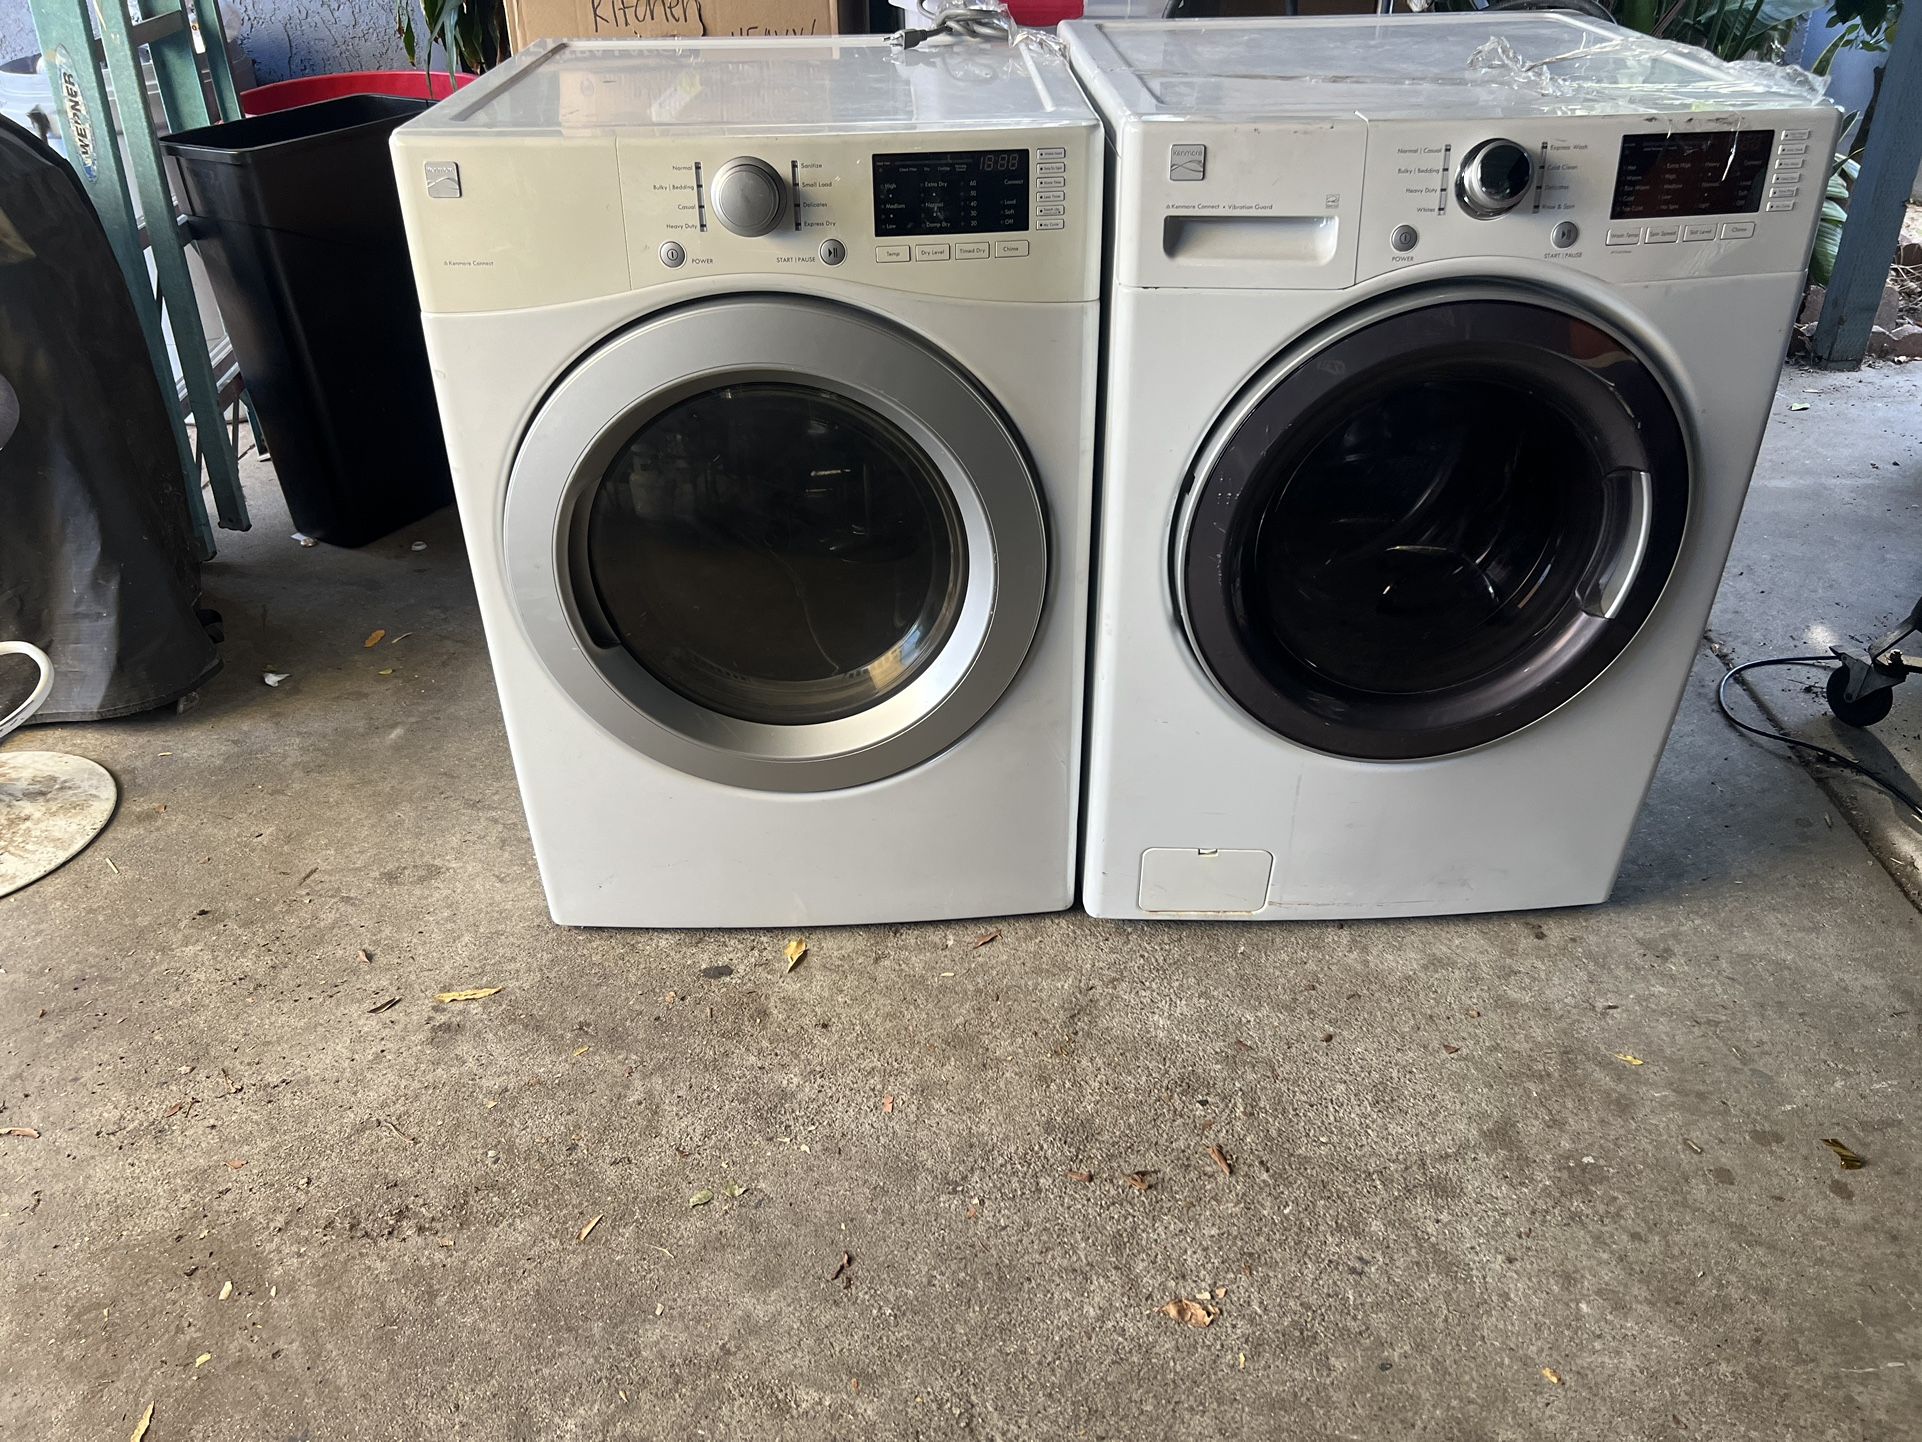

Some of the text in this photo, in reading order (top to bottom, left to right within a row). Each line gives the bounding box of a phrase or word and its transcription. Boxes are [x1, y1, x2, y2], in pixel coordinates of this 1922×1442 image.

[653, 184, 695, 192] Bulky Bedding
[975, 247, 986, 255] Dry
